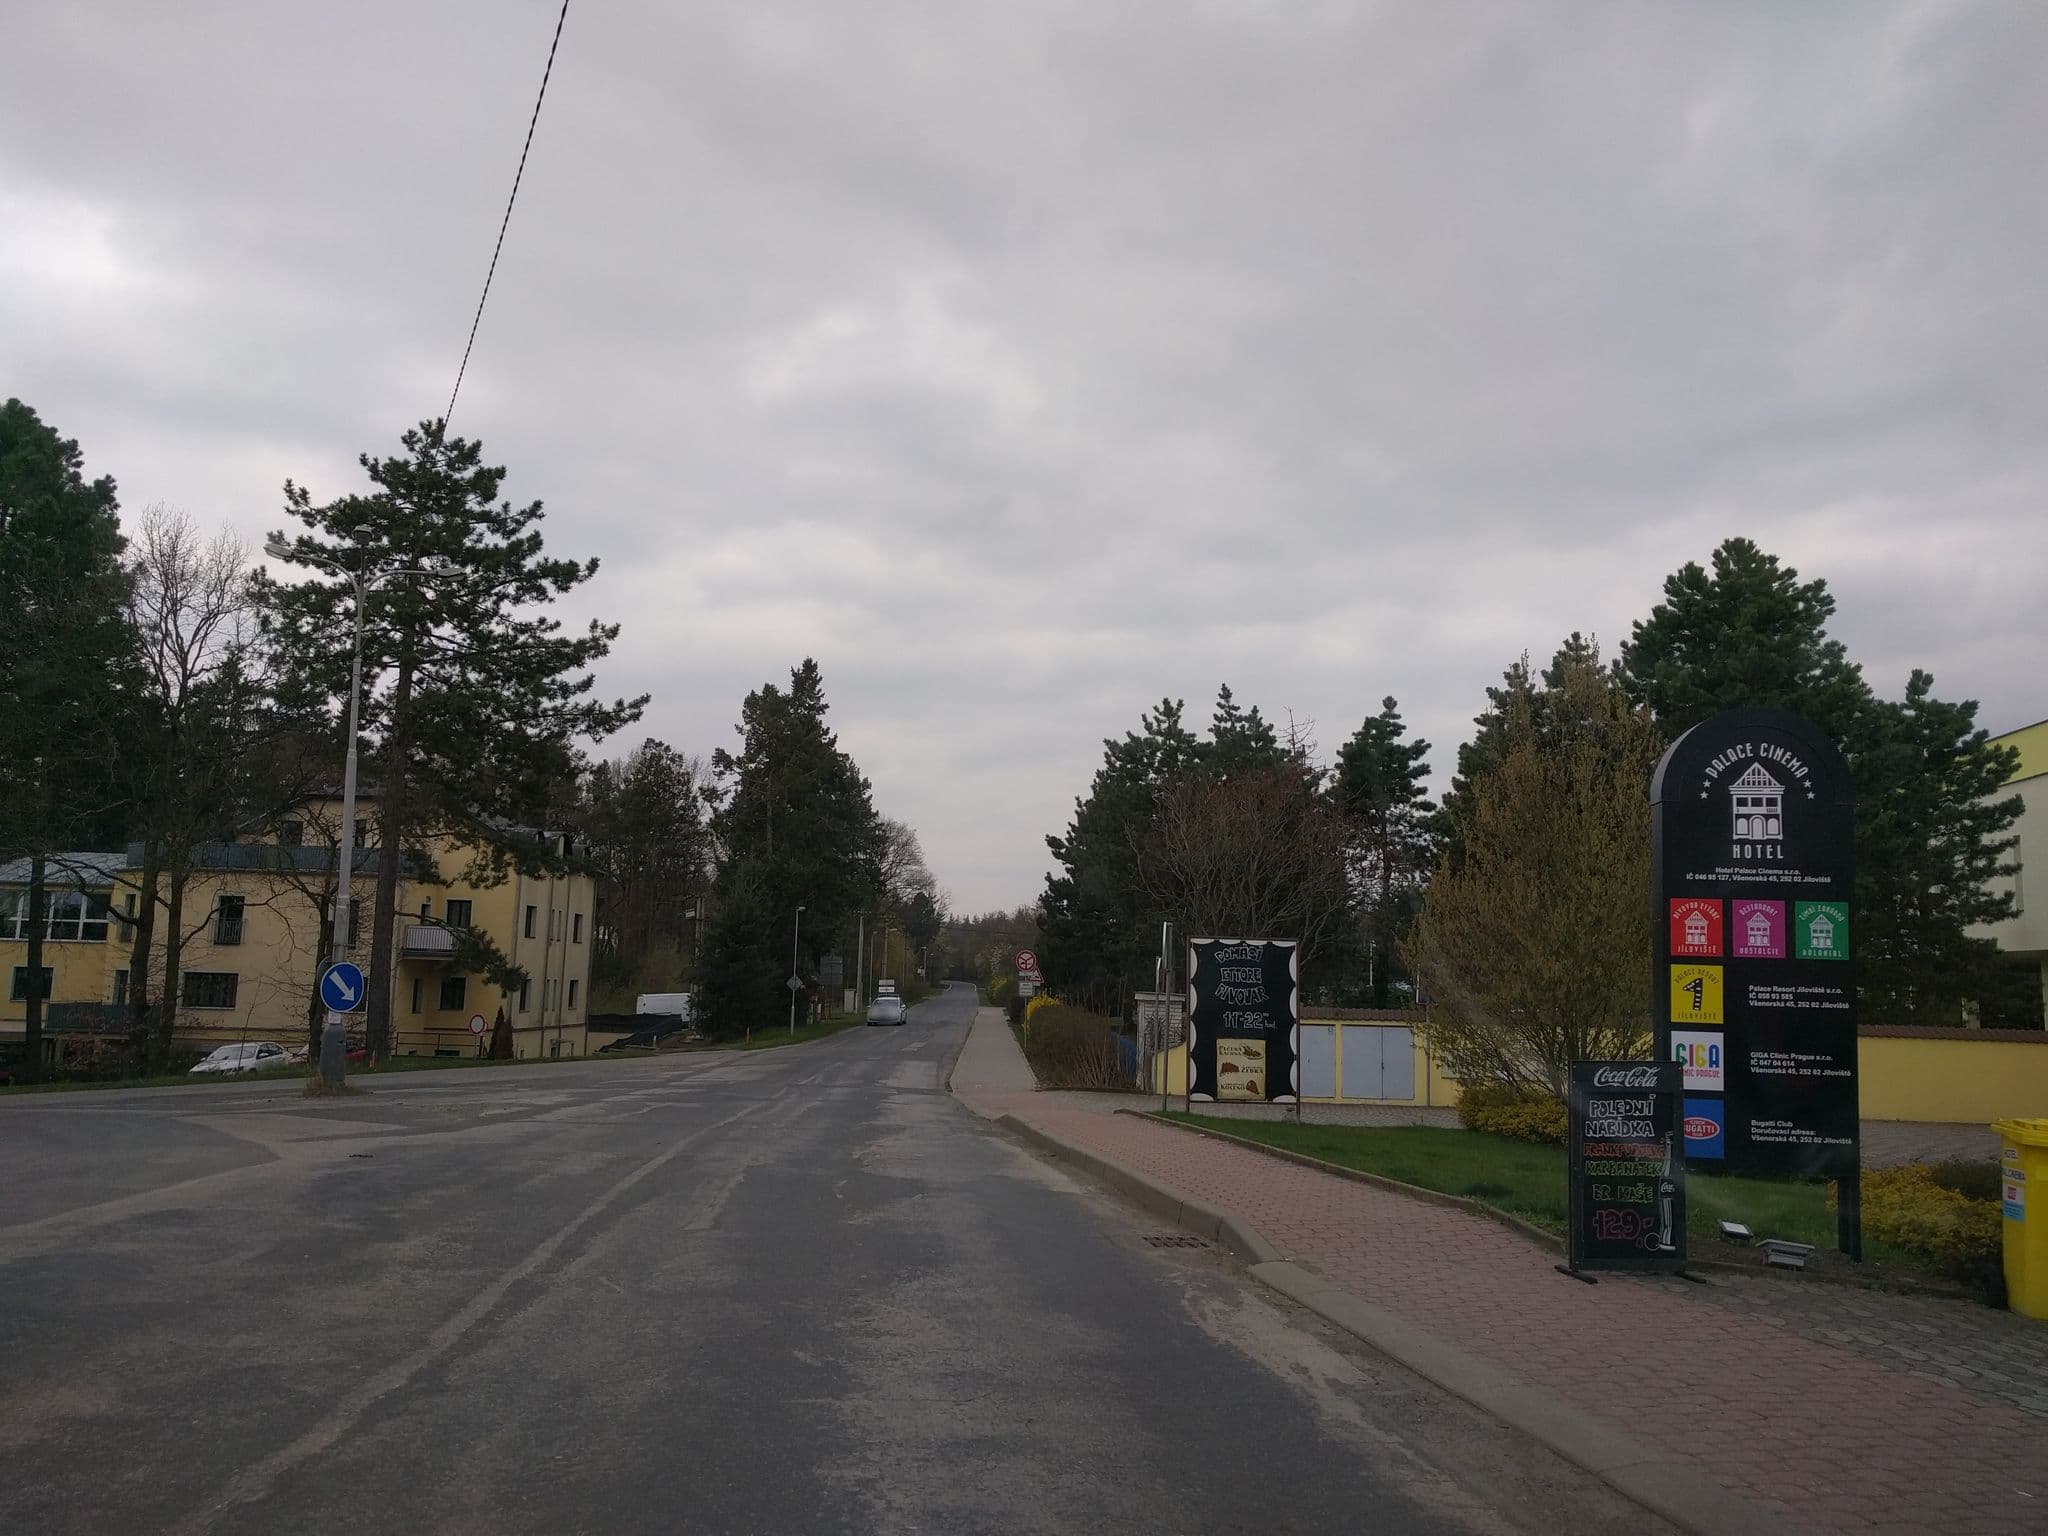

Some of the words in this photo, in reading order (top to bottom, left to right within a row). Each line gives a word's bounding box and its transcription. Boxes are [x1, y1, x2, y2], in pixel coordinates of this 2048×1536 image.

[1705, 742, 1754, 779] PALACE
[1759, 742, 1809, 779] CINEMA
[1732, 844, 1784, 859] HOTEL
[1734, 867, 1757, 875] Palace
[1220, 966, 1262, 983] ETTORE
[1772, 985, 1795, 993] Resort
[1750, 1051, 1769, 1059] GIGA
[1790, 1053, 1815, 1061] Prague
[1593, 1066, 1661, 1087] Coca-Cola
[1589, 1093, 1657, 1118] POLEDNÍ
[1585, 1117, 1655, 1138] NABÍDKA
[1685, 1124, 1715, 1133] UGATTI
[1751, 1119, 1776, 1128] Bugatti
[1776, 1120, 1794, 1128] Club
